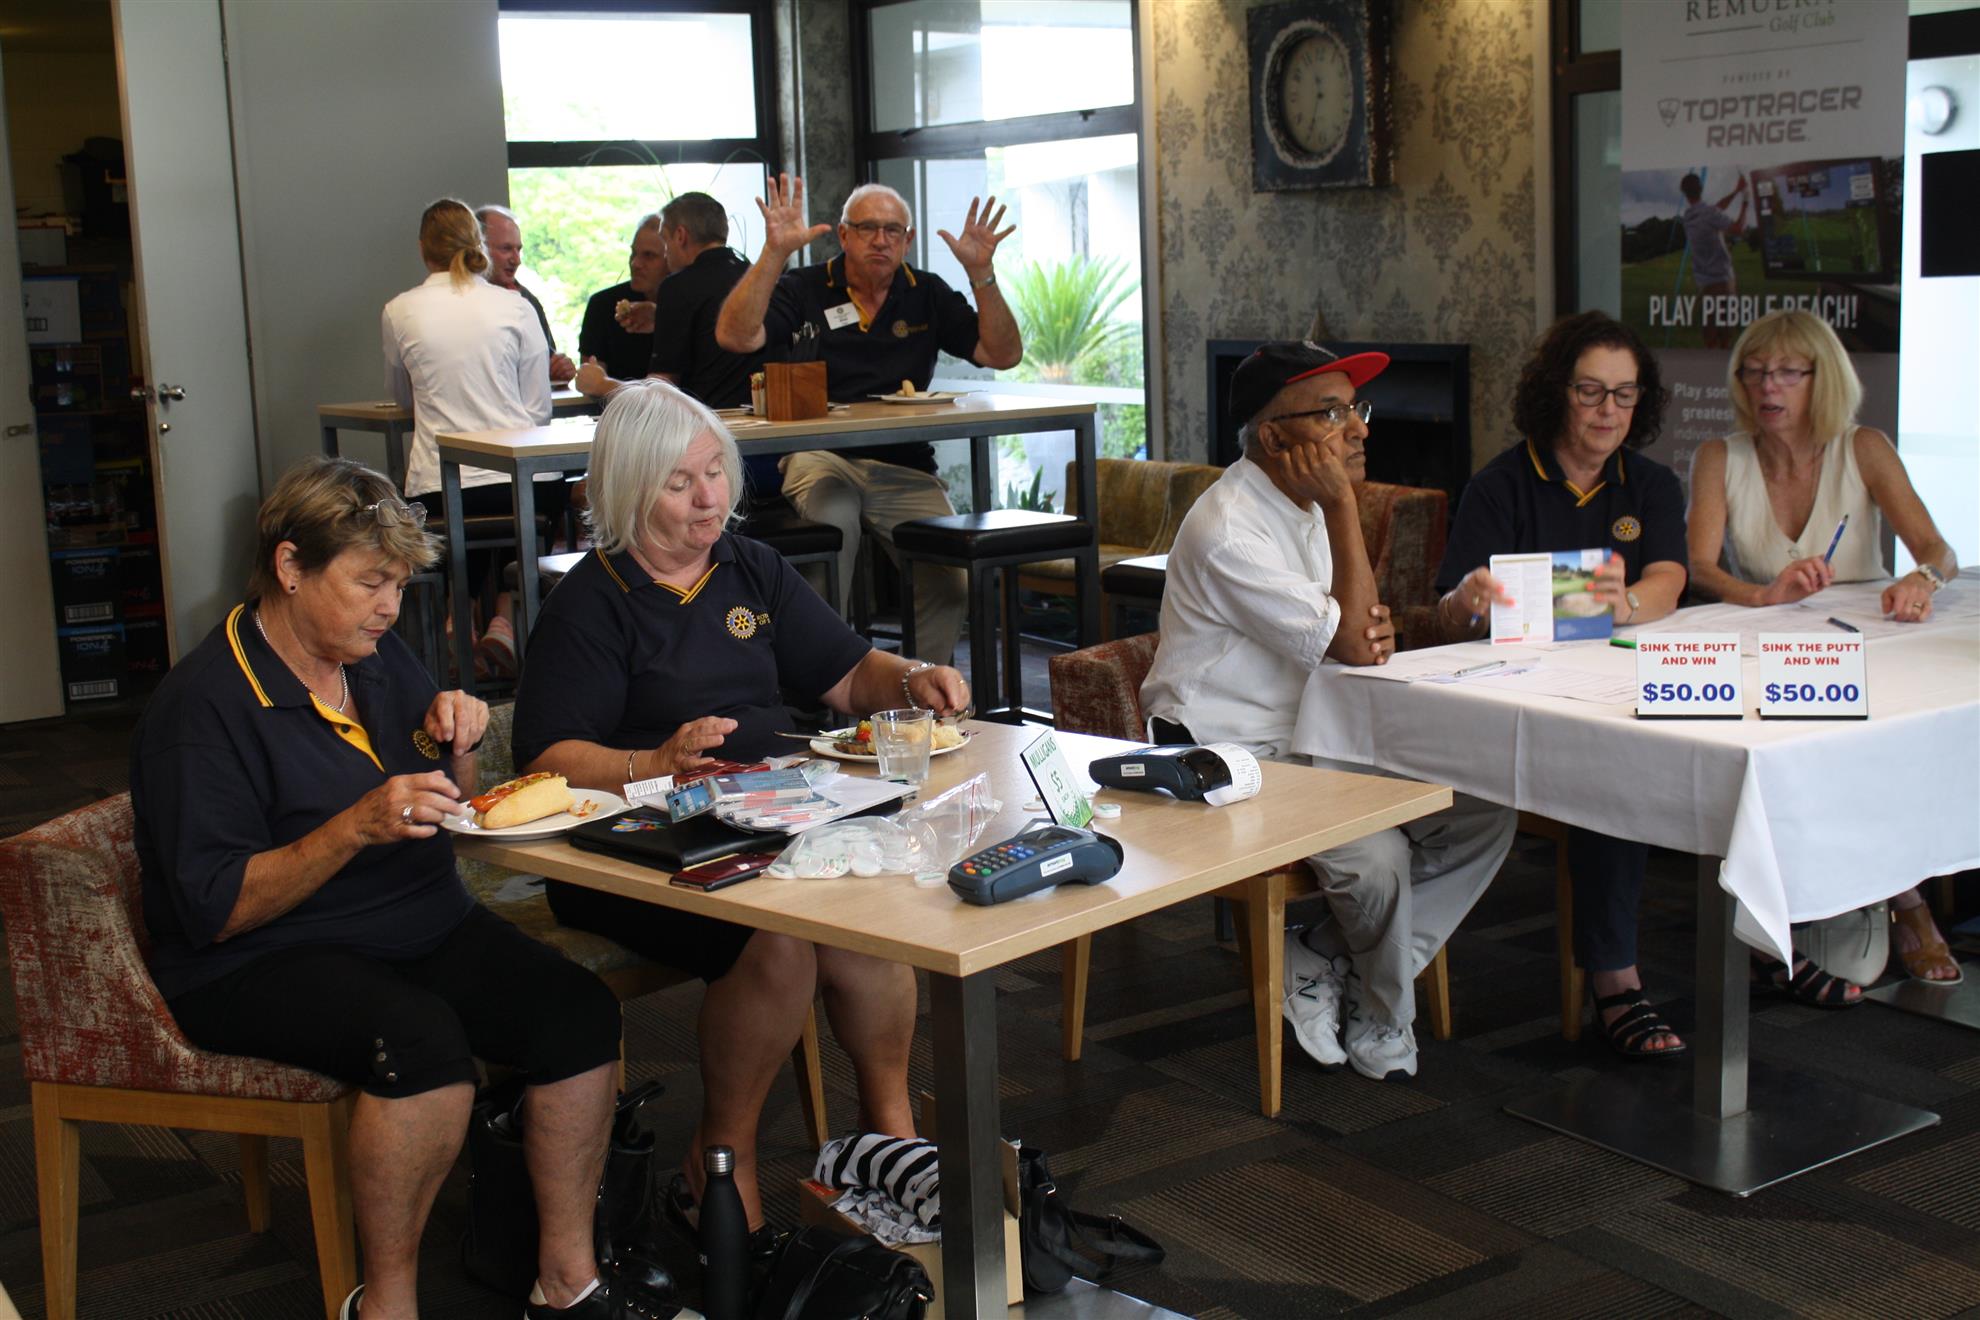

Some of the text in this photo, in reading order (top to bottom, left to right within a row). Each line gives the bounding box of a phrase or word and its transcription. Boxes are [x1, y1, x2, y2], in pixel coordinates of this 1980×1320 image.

[1686, 0, 1833, 22] REMUE
[1769, 9, 1835, 33] Golf Club
[1683, 85, 1862, 122] TOPTRACER
[1706, 119, 1807, 148] RANGE
[1650, 295, 1696, 327] PLAY
[1674, 383, 1701, 400] Play
[1640, 643, 1737, 652] SINK THE PUTT
[1762, 643, 1860, 652] SINK THE PUTT
[1661, 656, 1716, 665] AND WIN
[1784, 656, 1840, 665] AND WIN
[1642, 682, 1735, 704] $50.00
[1765, 682, 1859, 704] $50.00
[1029, 736, 1057, 768] MULLIGANS
